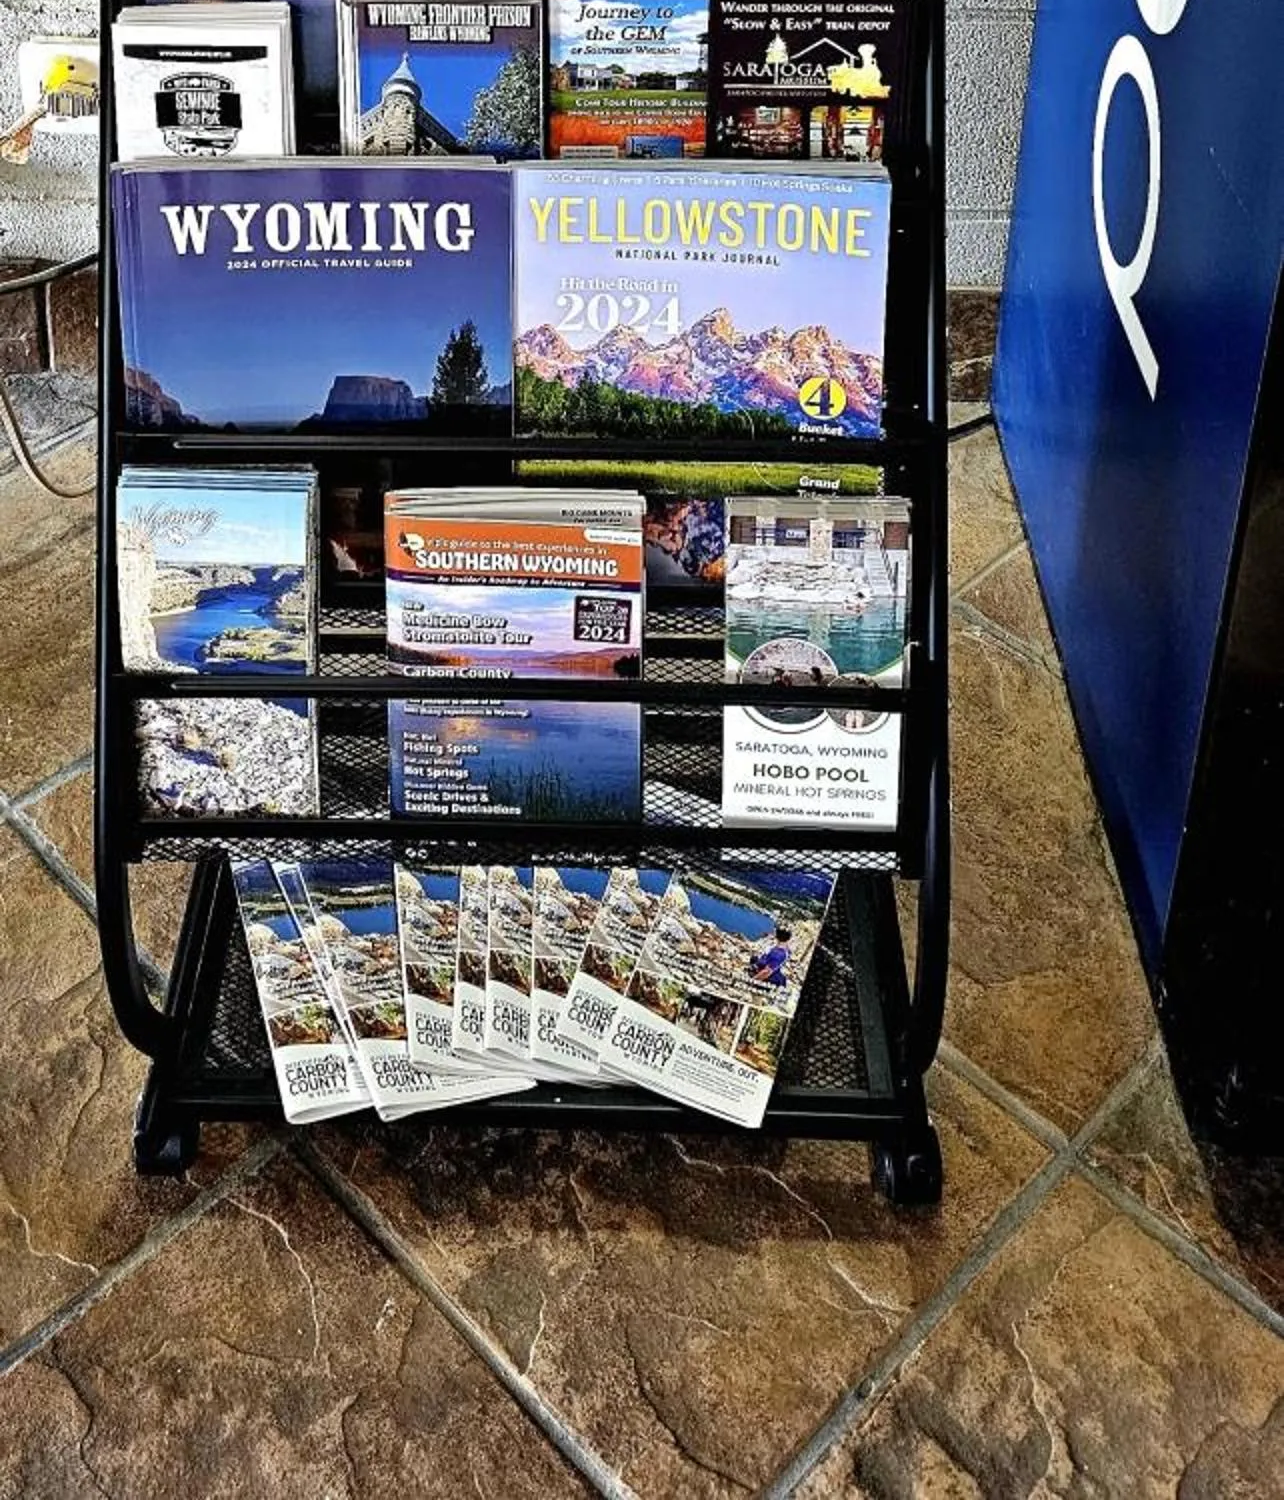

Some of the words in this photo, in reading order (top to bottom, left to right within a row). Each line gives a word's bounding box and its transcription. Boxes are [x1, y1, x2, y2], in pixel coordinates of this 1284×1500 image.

[368, 3, 427, 26] WYOMING
[428, 3, 487, 26] FRONTIER
[489, 5, 531, 27] PRISON
[575, 3, 651, 24] Journey
[656, 6, 674, 19] to
[720, 2, 769, 13] WANDER
[771, 3, 823, 13] THROUGH
[825, 3, 844, 13] THE
[846, 3, 895, 14] ORIGINAL
[769, 17, 781, 31] &
[825, 21, 855, 31] TRAIN
[857, 21, 891, 31] DEPOT
[585, 25, 615, 41] the
[620, 25, 667, 41] GEM
[723, 61, 827, 77] SARATOGA
[201, 111, 221, 125] Park
[160, 201, 475, 255] WYOMING
[529, 196, 872, 258] YELLOWSTONE
[226, 260, 257, 271] 2024
[261, 258, 319, 269] OFFICIAL
[323, 258, 370, 268] TRAVEL
[374, 258, 413, 268] GUIDE
[615, 249, 678, 262] NATIONAL
[683, 252, 716, 263] PARK
[722, 254, 780, 267] JOURNAL
[559, 276, 585, 291] Hit
[586, 277, 616, 292] the
[618, 277, 657, 293] Road
[660, 279, 678, 293] in
[555, 292, 682, 335] 2024
[805, 377, 835, 416] 4
[798, 422, 844, 436] Bucket
[799, 475, 841, 489] Grand
[493, 540, 510, 550] the
[415, 550, 519, 571] SOUTHERN
[521, 555, 618, 577] WYOMING
[404, 612, 468, 628] Medicine
[471, 615, 507, 628] Bow
[499, 631, 533, 644] Tour
[578, 625, 626, 642] 2024
[403, 666, 454, 678] Carbon
[459, 667, 511, 678] County
[404, 742, 443, 754] Fishing
[446, 744, 478, 754] Spots
[735, 741, 813, 757] SARATOGA,
[817, 746, 889, 759] WYOMING
[427, 768, 469, 779] Springs
[753, 764, 810, 780] HOBO
[815, 767, 870, 783] POOL
[404, 790, 440, 801] Scenic
[441, 792, 478, 802] Drives
[480, 793, 489, 802] &
[733, 782, 792, 798] MINERAL
[795, 786, 823, 799] HOT
[827, 787, 888, 801] SPRINGS
[405, 802, 449, 815] Exciting
[451, 803, 521, 816] Destinations
[617, 1020, 677, 1054] CARBON
[611, 1033, 673, 1068] COUNTY
[285, 1059, 347, 1082] CARBON
[289, 1074, 348, 1096] COUNTY
